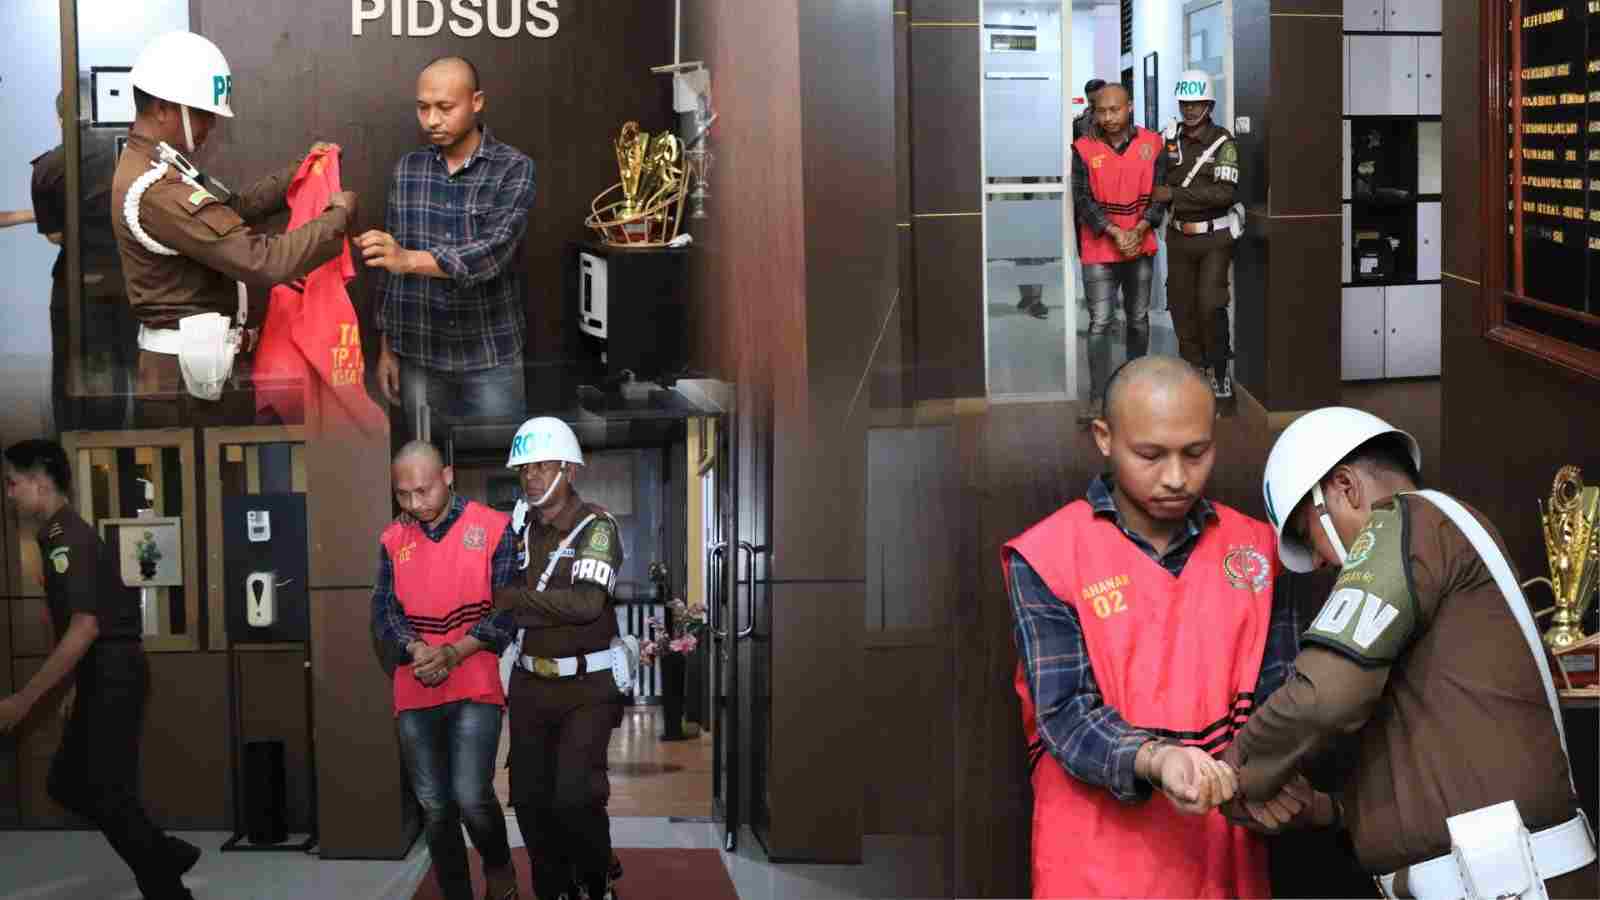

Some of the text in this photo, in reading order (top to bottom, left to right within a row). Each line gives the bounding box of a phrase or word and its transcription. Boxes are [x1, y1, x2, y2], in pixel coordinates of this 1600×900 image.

[351, 0, 559, 38] PIDSUS
[1174, 81, 1206, 97] PROV
[1094, 591, 1128, 619] 02
[1311, 588, 1400, 649] OV
